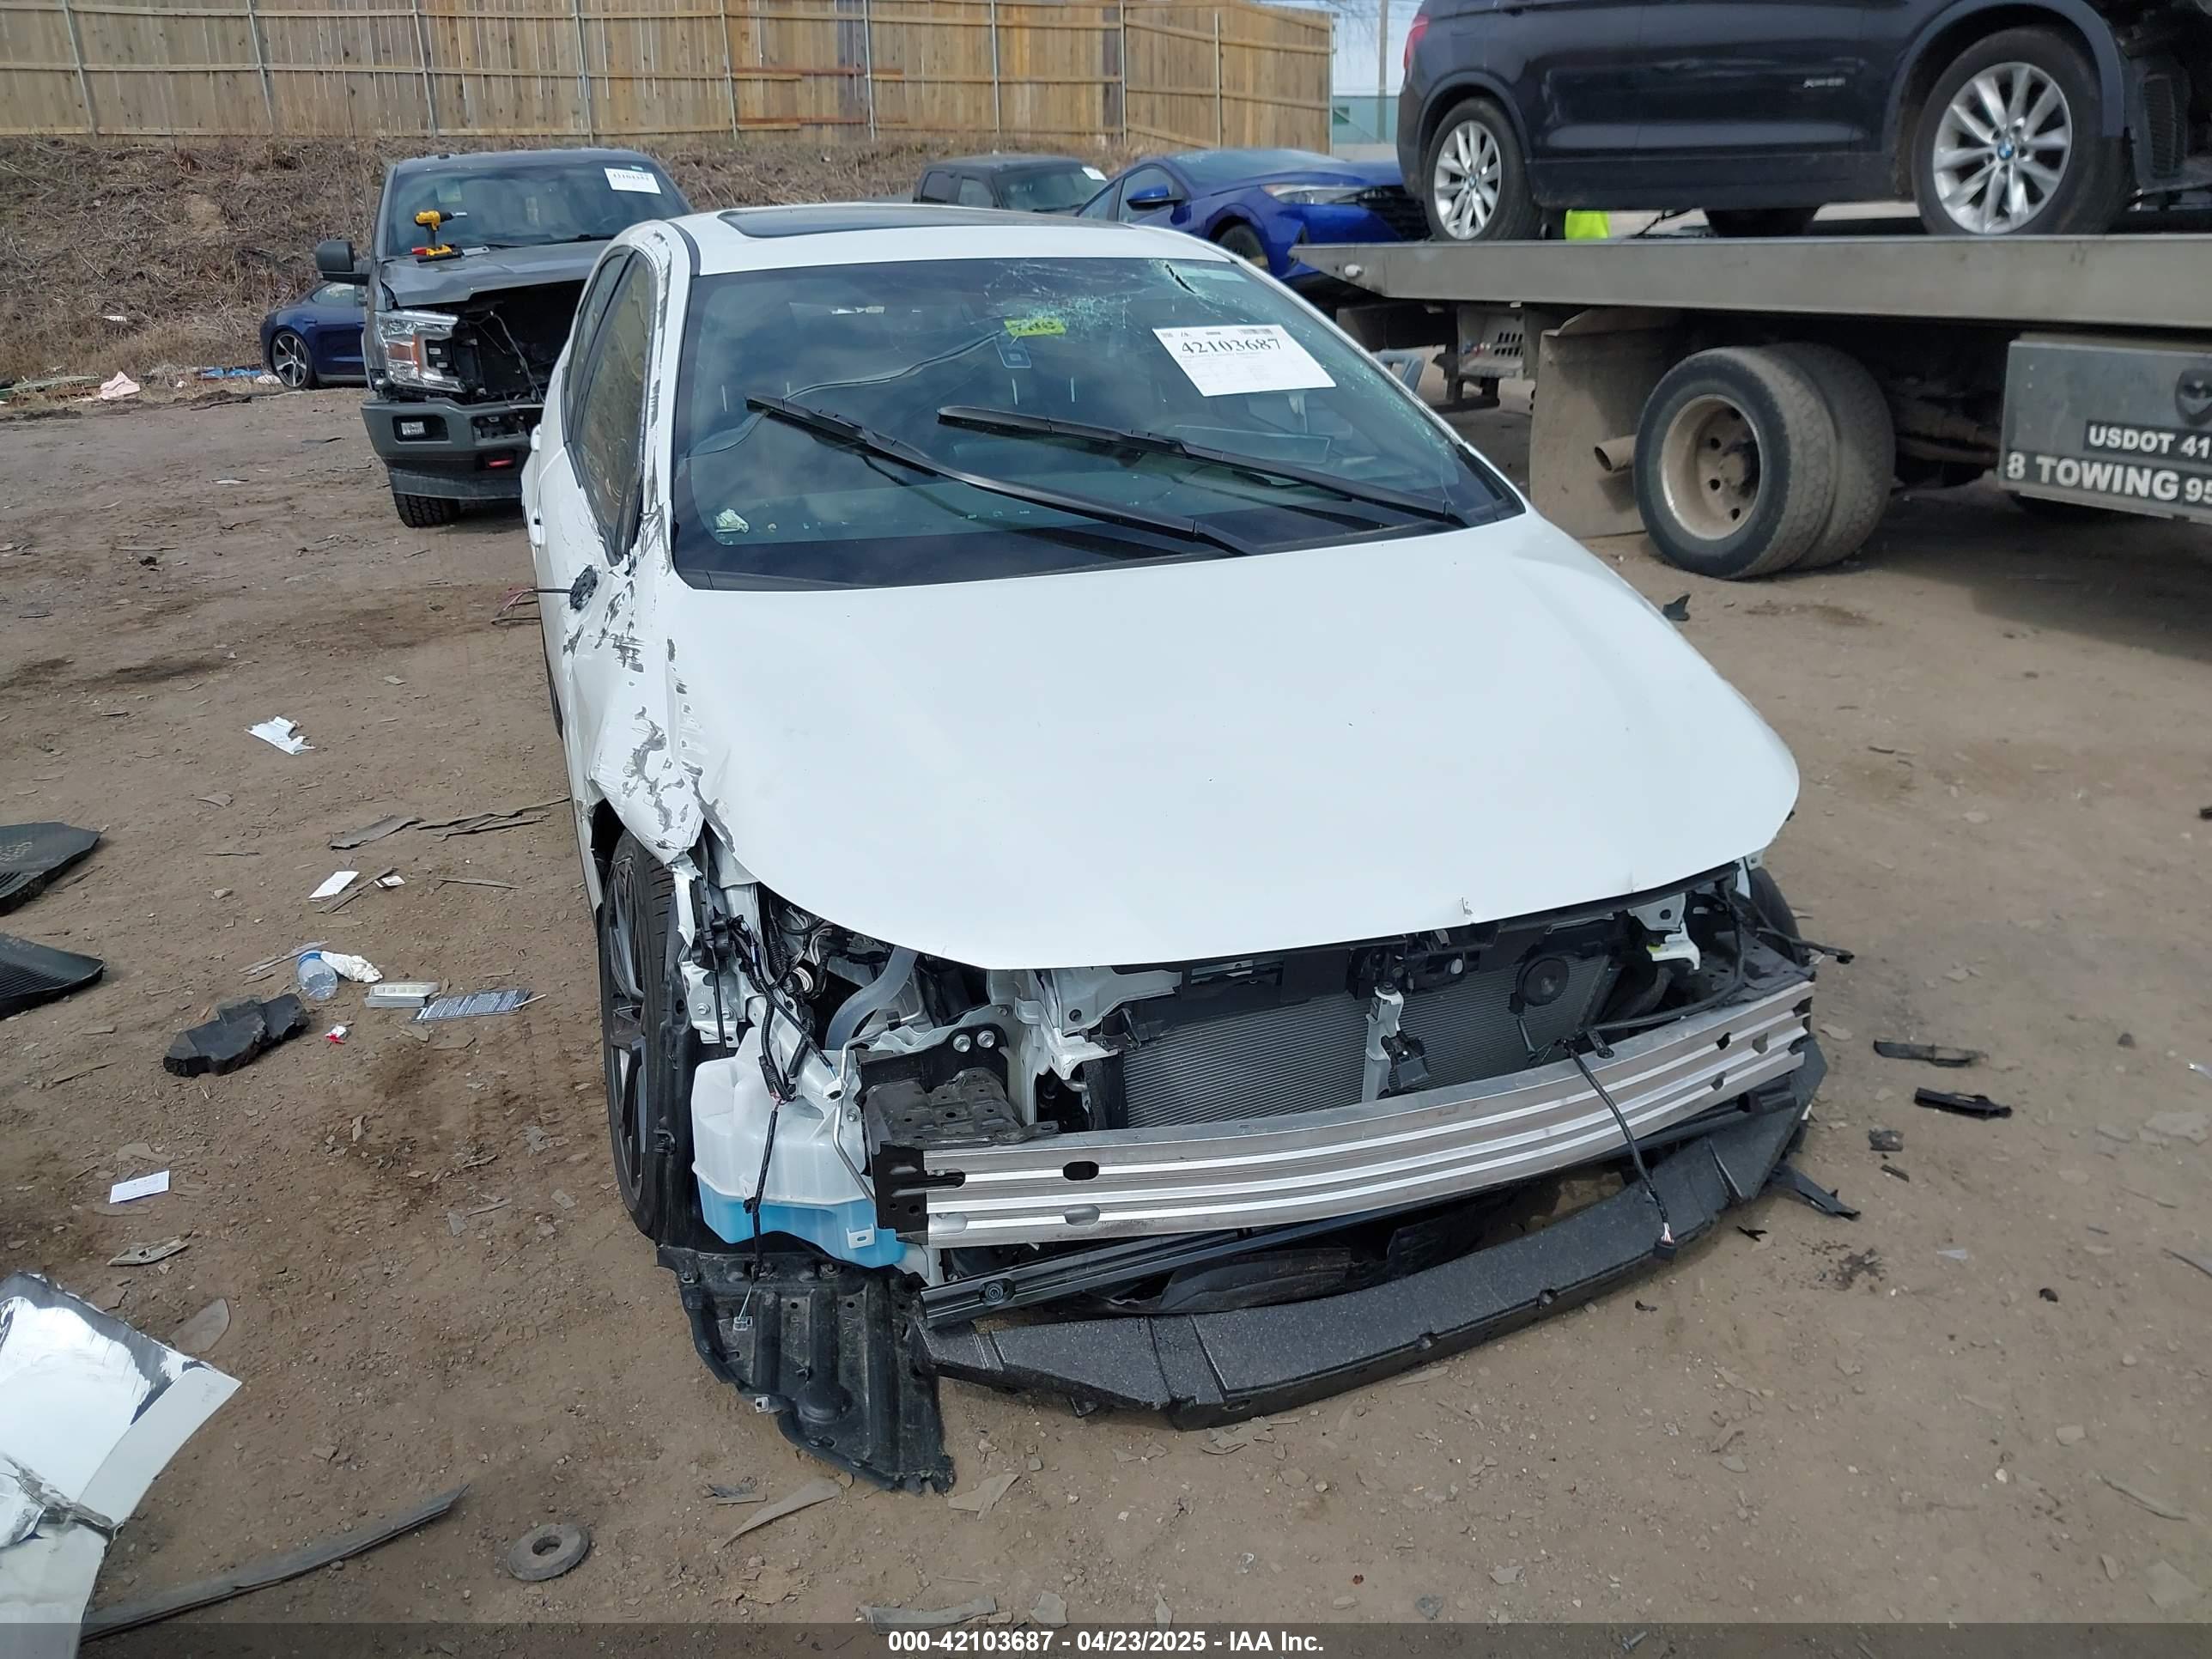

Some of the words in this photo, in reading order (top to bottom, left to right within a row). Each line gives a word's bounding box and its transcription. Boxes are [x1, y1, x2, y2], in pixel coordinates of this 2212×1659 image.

[1181, 337, 1281, 354] 42103687
[2088, 425, 2176, 453] USDOT
[2036, 456, 2179, 501] TOWING
